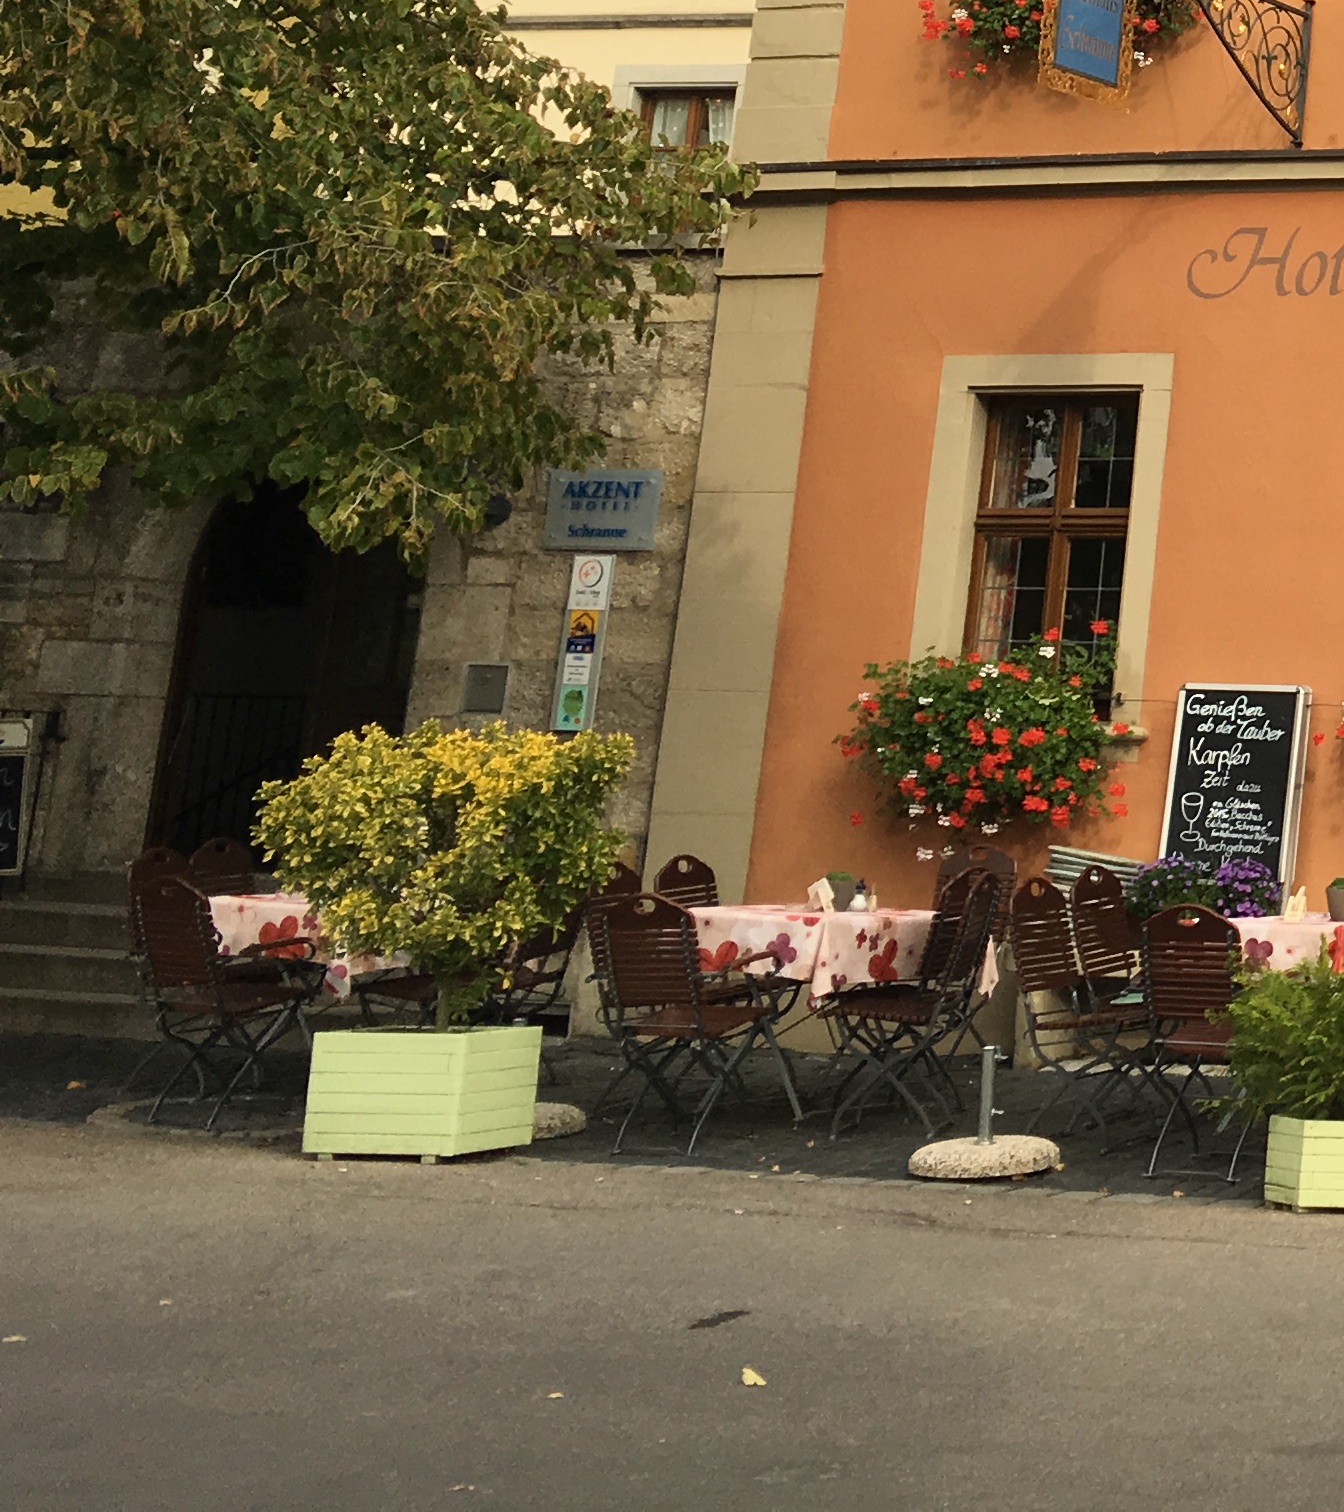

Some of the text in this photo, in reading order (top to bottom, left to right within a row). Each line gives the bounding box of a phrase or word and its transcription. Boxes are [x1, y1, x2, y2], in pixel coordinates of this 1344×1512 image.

[562, 480, 644, 499] AKZENT
[1186, 693, 1266, 722] Genießen
[1197, 717, 1286, 742] ob der Tauber
[1187, 736, 1251, 773] Karpfen
[1200, 769, 1231, 789] Zeit
